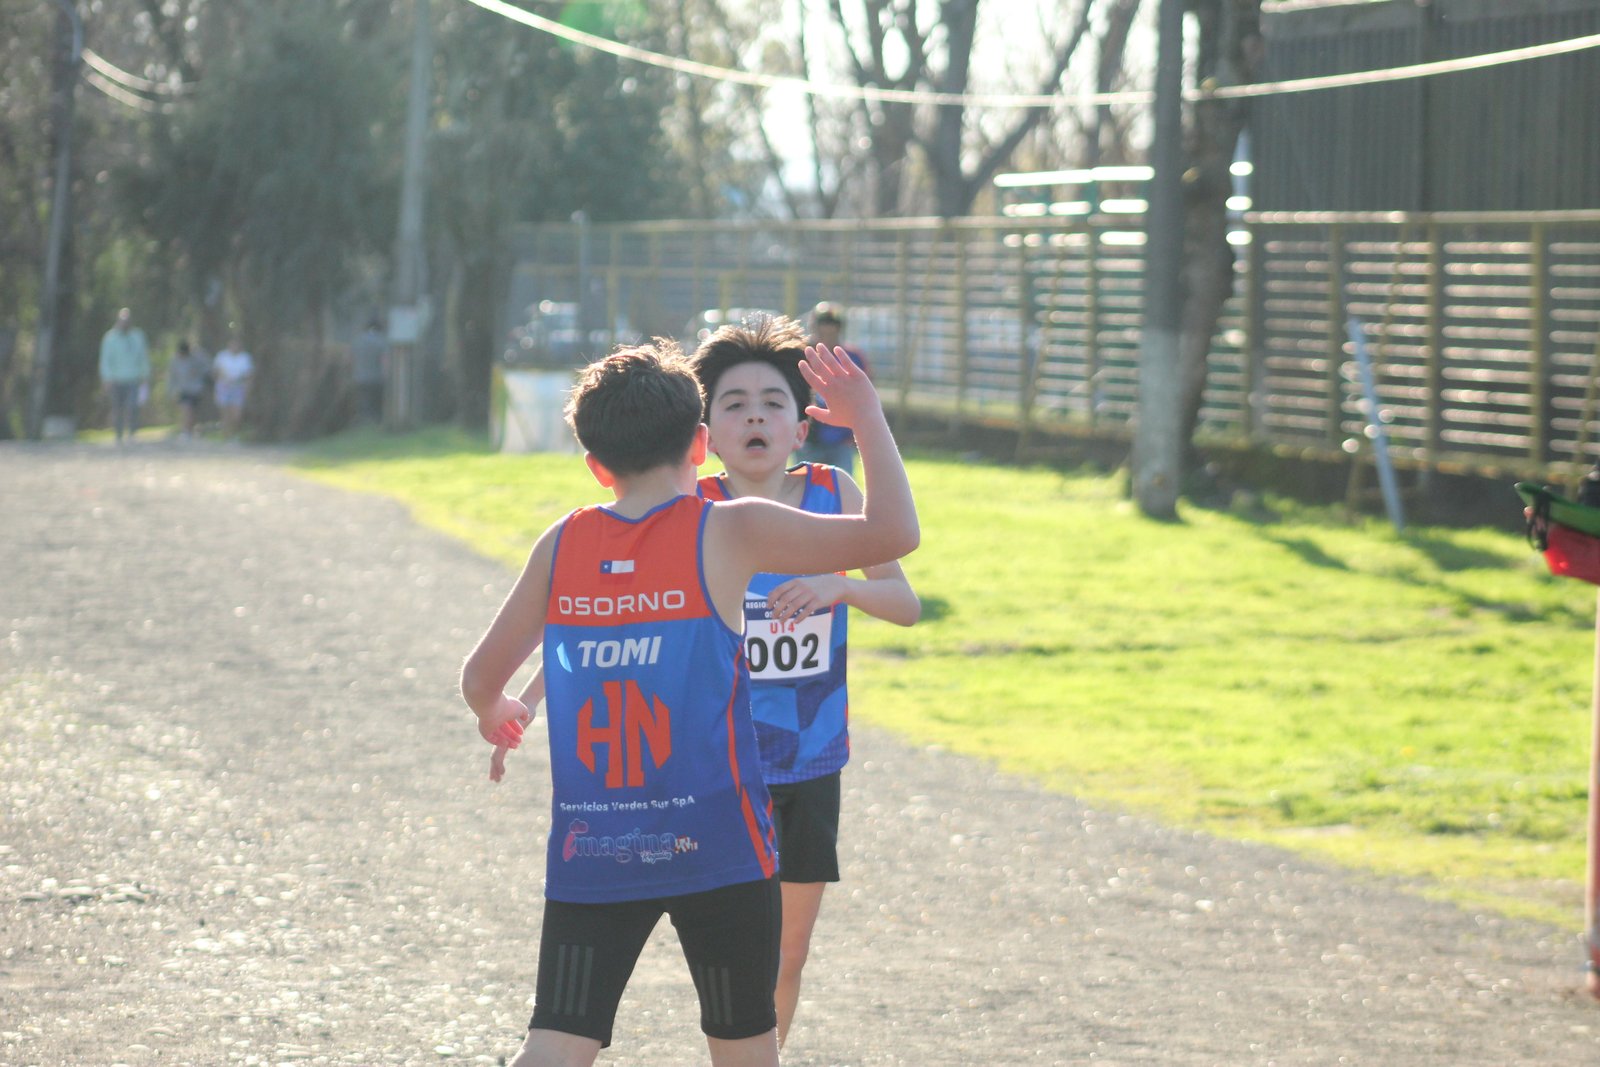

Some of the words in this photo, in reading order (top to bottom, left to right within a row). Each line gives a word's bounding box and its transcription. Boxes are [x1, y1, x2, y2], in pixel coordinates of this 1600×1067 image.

[558, 590, 685, 616] OSORNO
[577, 636, 663, 668] TOMI
[747, 633, 819, 673] 002
[576, 679, 673, 789] HN
[559, 801, 609, 812] Servicios
[611, 800, 648, 811] Verdes
[650, 799, 670, 810] Sur
[672, 794, 696, 808] SpA
